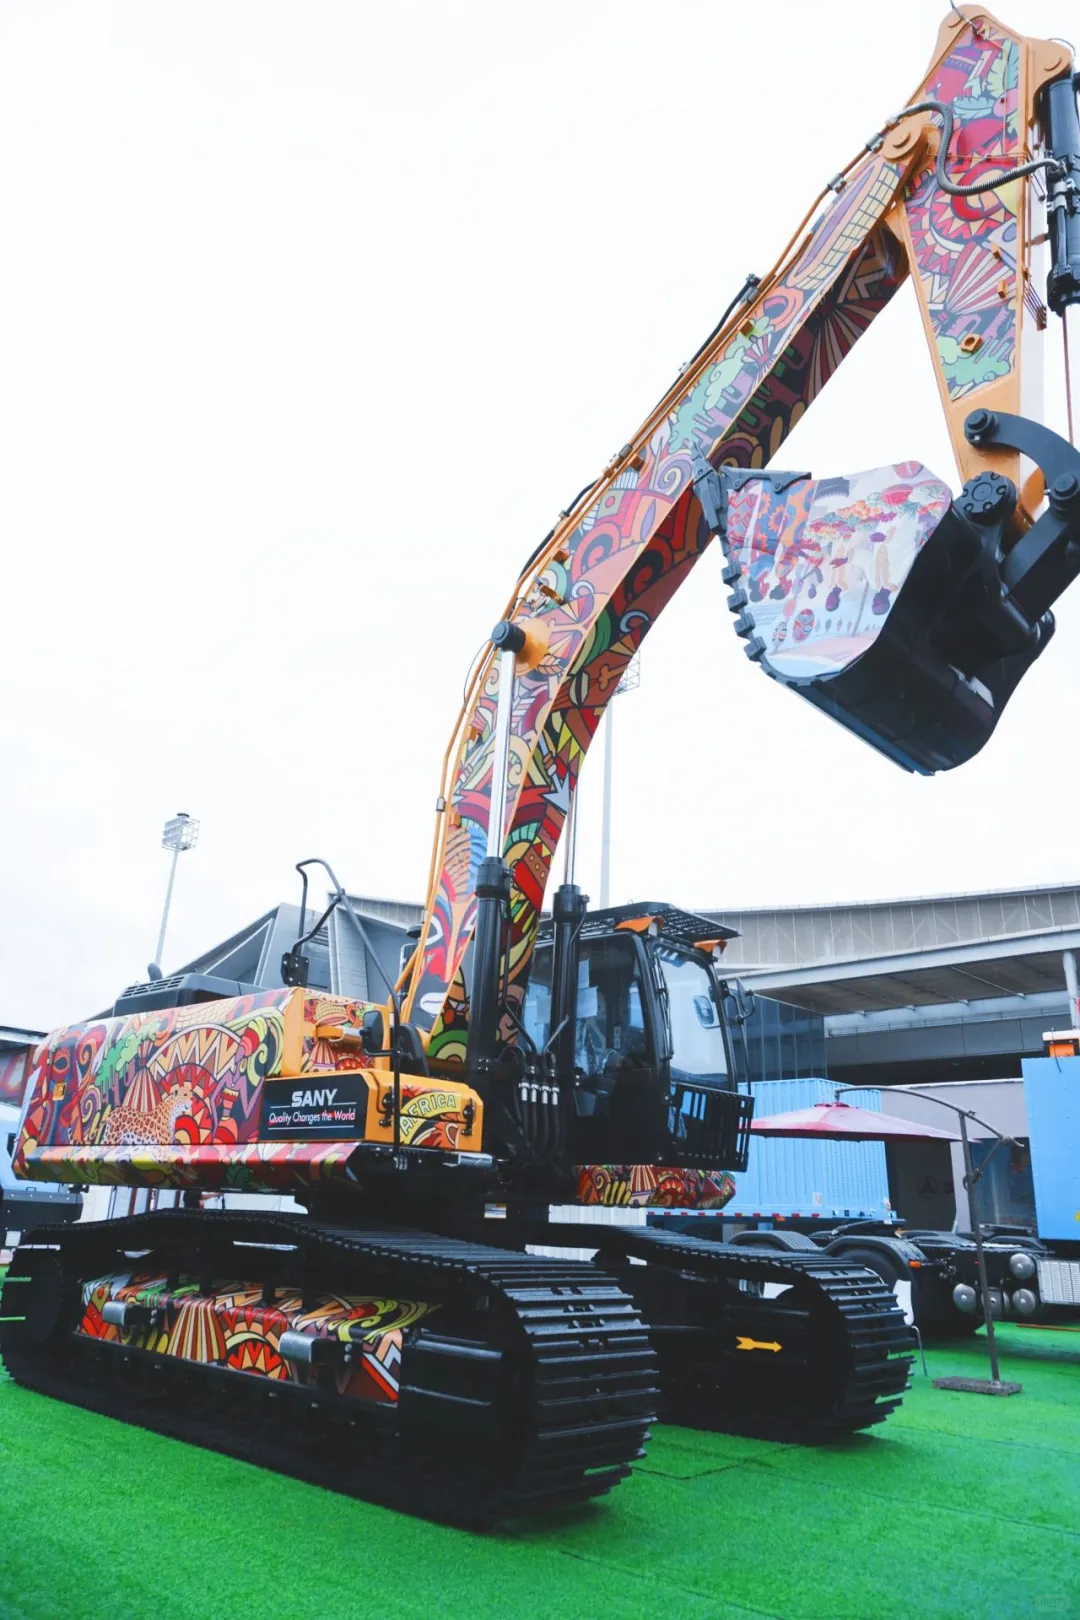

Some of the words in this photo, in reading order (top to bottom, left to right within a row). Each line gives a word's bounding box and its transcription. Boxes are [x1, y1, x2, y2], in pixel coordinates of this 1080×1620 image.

[291, 1088, 338, 1108] SANY
[268, 1111, 292, 1126] Quality
[292, 1111, 321, 1125] Changes
[321, 1109, 333, 1122] the
[333, 1107, 356, 1121] World
[399, 1094, 457, 1137] AFRICA
